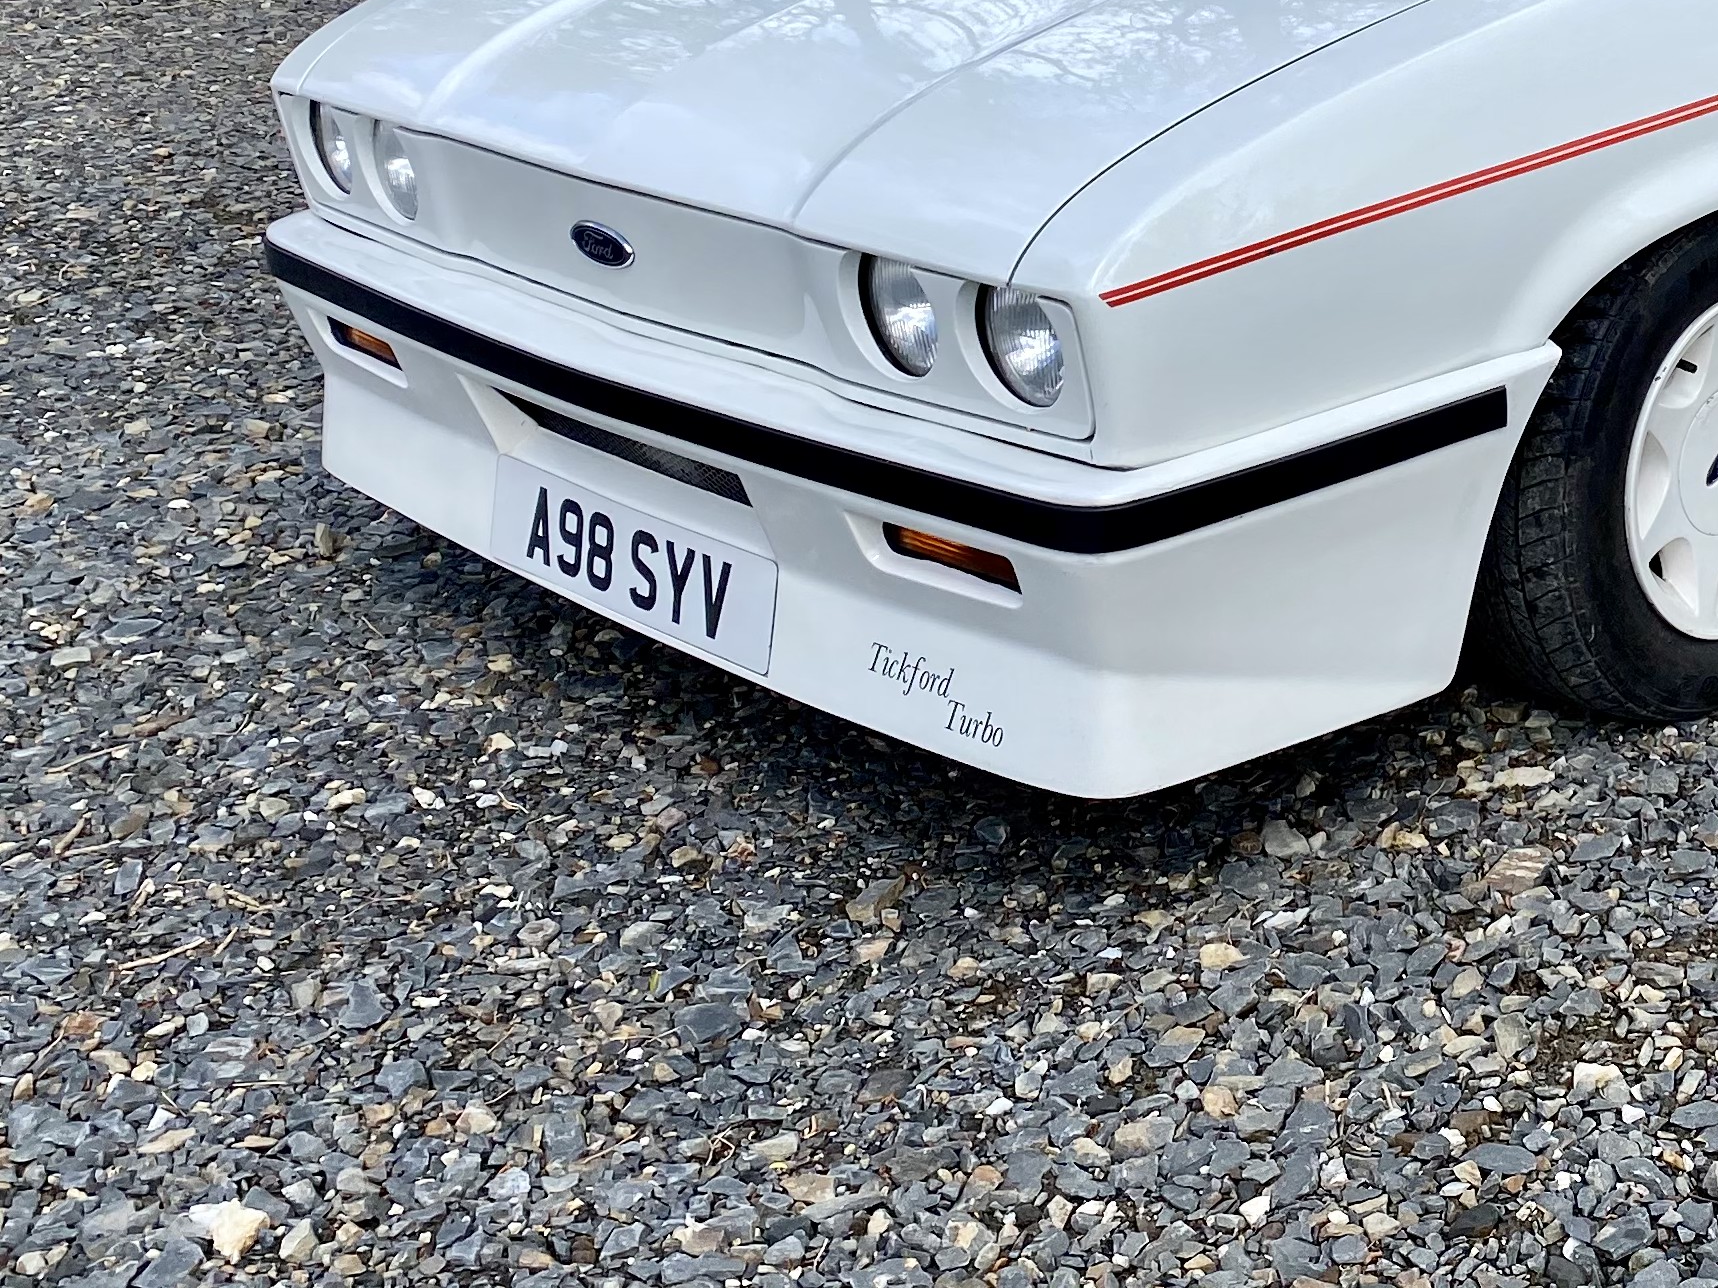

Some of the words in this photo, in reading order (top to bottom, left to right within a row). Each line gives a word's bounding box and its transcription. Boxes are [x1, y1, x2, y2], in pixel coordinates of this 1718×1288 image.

[582, 231, 613, 259] Ford
[527, 486, 614, 592] A98
[629, 529, 732, 640] SYV
[868, 642, 955, 698] Tickford
[944, 699, 1004, 747] Turbo
